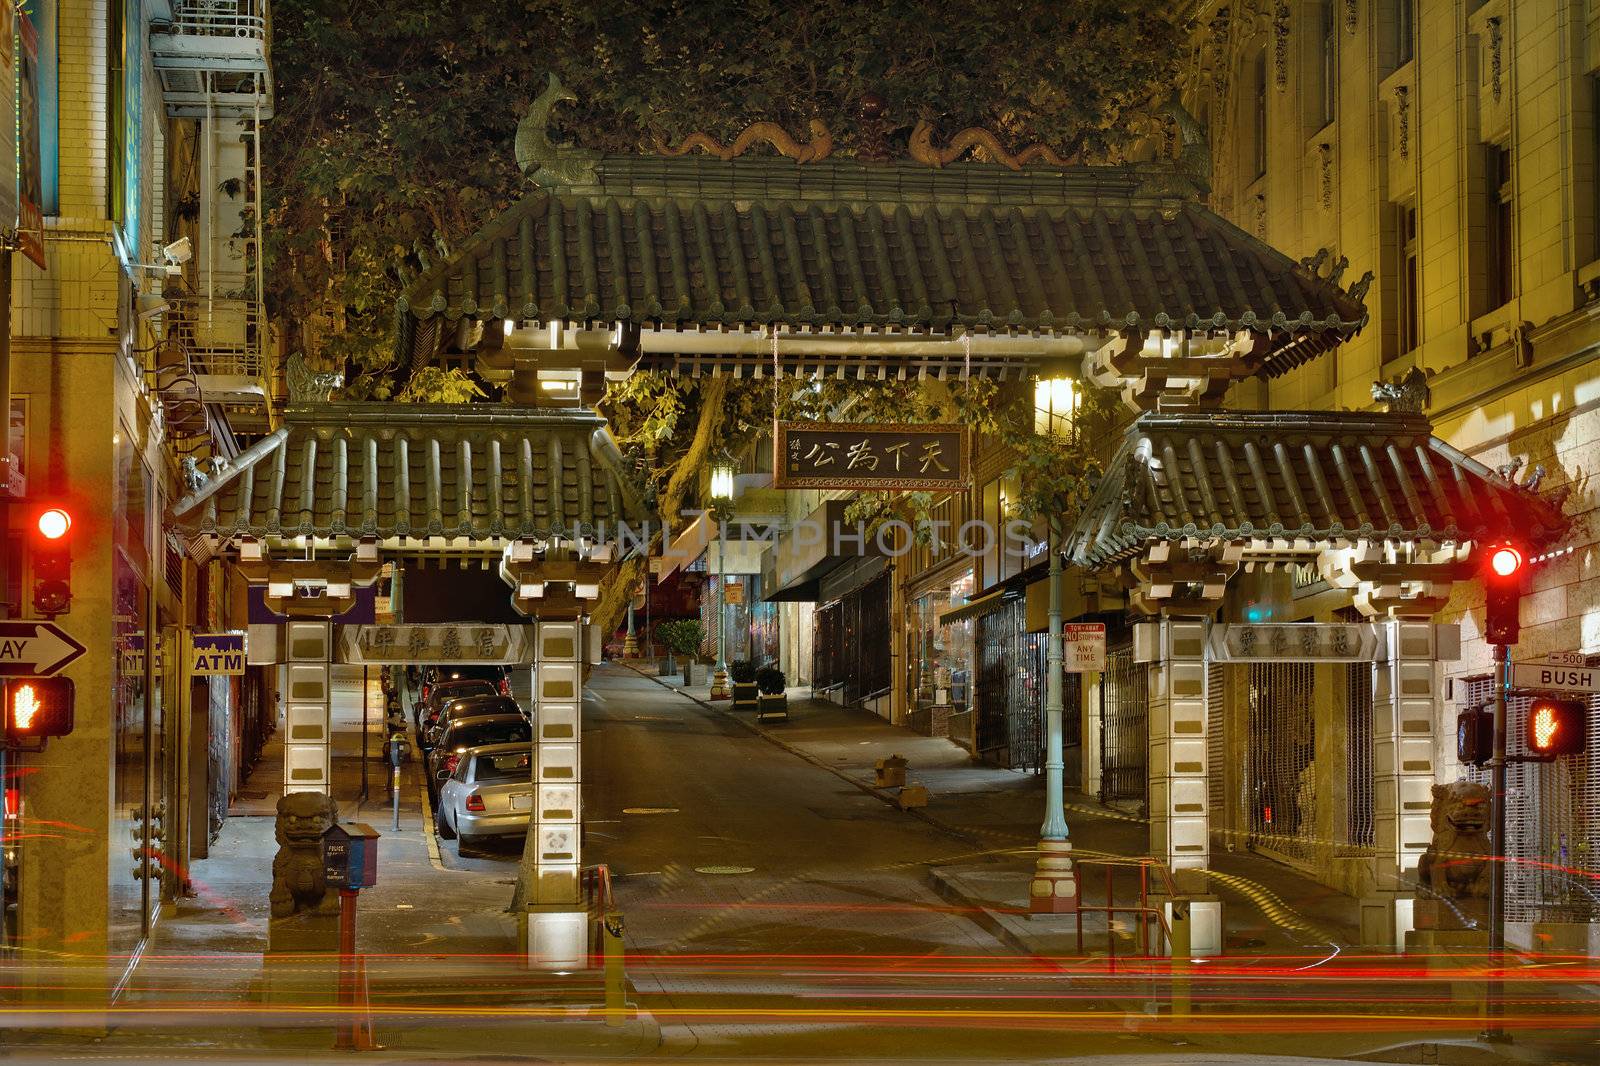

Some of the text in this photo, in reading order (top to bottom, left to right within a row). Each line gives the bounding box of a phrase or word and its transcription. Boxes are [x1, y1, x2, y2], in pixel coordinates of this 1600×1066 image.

[1066, 631, 1104, 641] NO STOPPING
[1076, 645, 1094, 653] ANY
[194, 655, 242, 670] ATM
[1562, 654, 1583, 664] 500
[1541, 670, 1592, 687] BUSH
